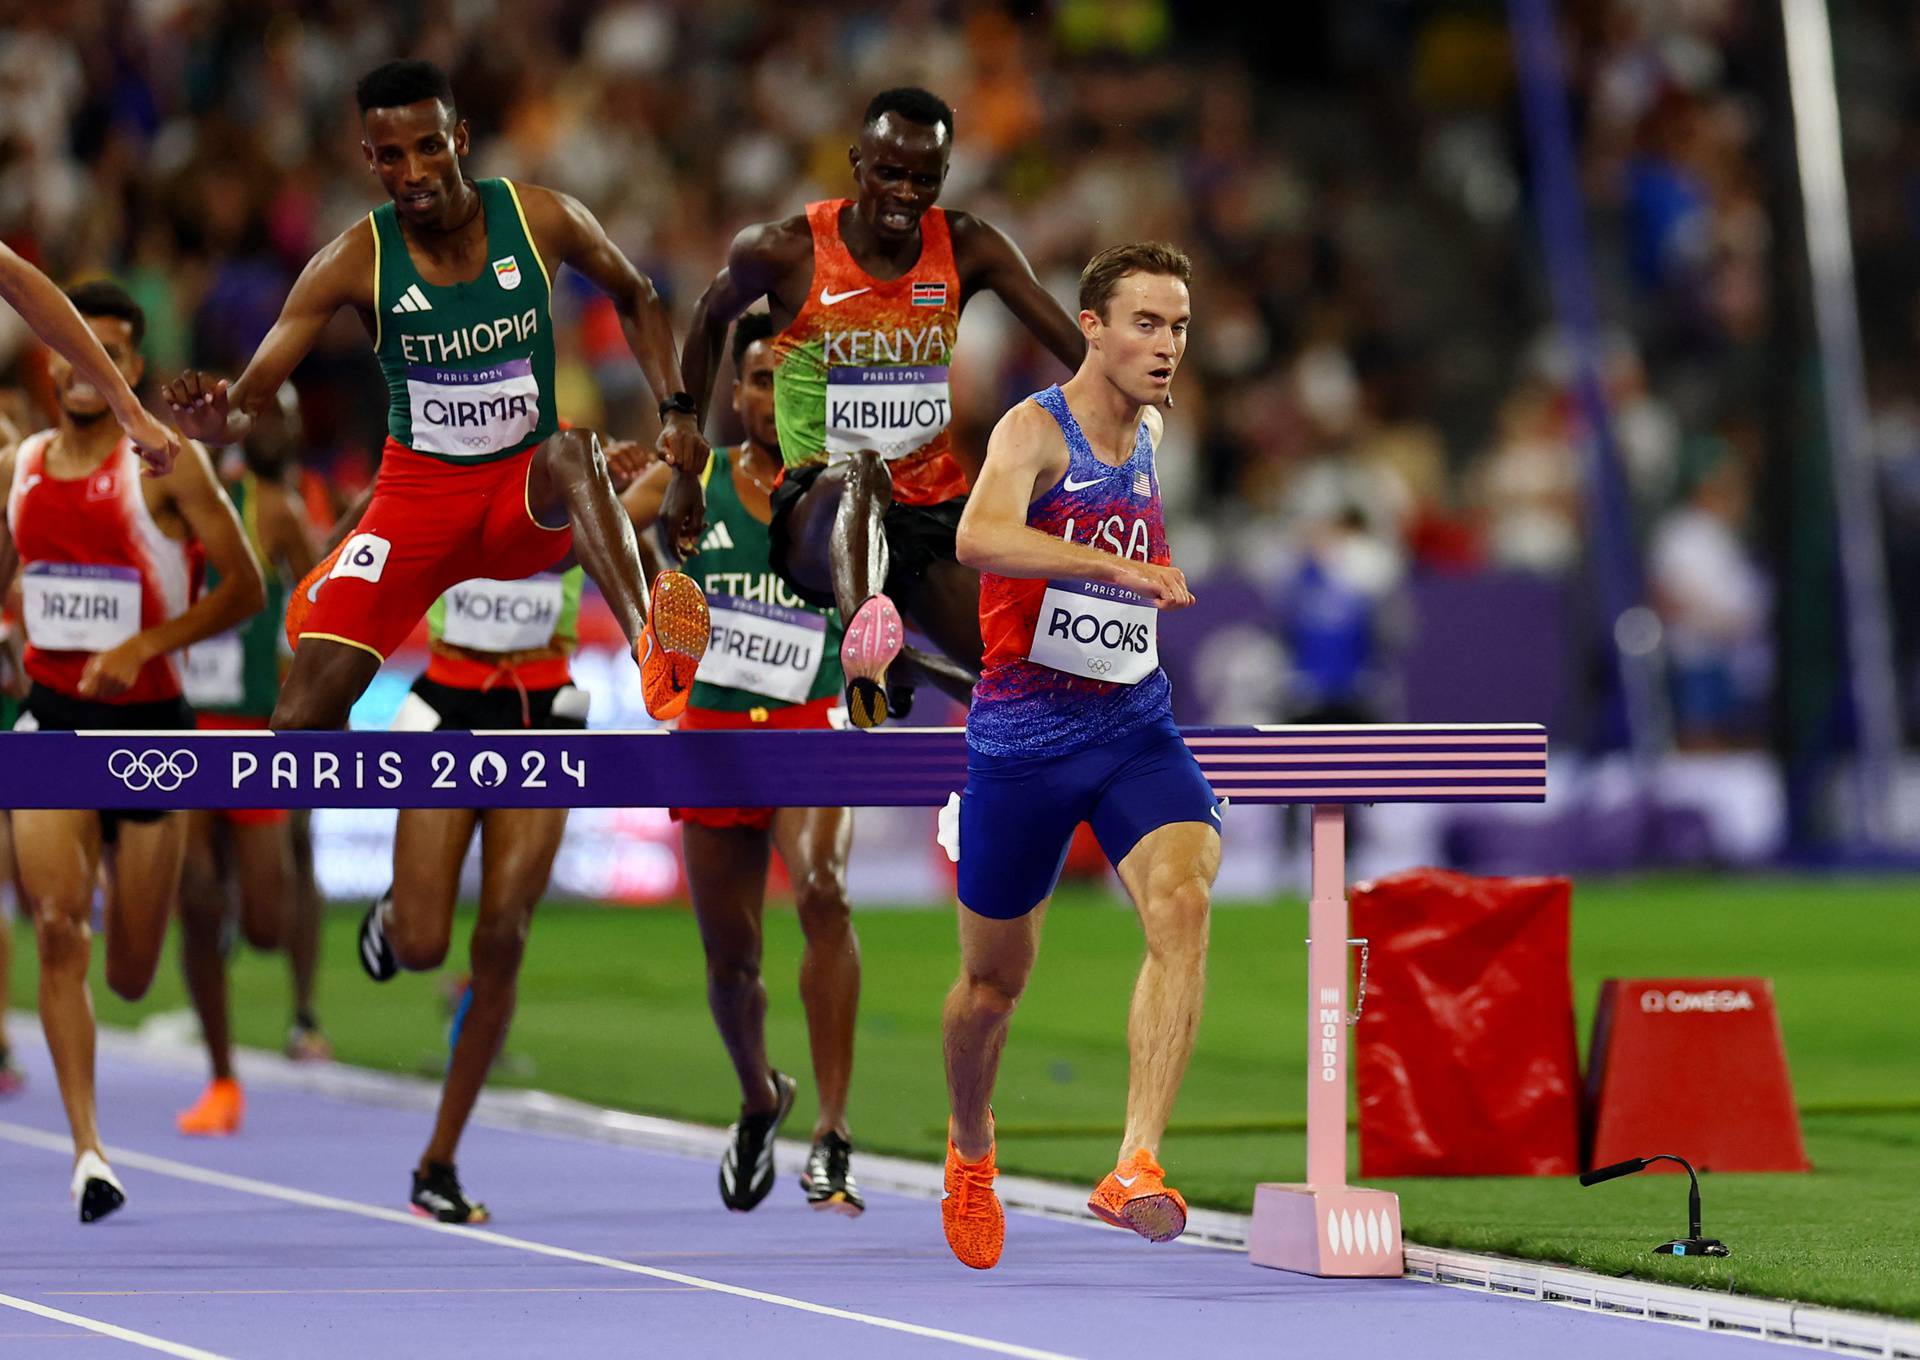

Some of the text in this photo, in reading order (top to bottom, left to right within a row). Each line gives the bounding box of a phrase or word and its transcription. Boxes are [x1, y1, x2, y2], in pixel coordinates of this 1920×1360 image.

[401, 307, 538, 363] ETHIOPIA
[824, 324, 947, 364] KENYA
[436, 369, 503, 382] PARIS 2024
[862, 371, 895, 381] PARIS
[423, 395, 528, 427] GIRMA
[832, 399, 946, 429] KIBIWOT
[343, 544, 375, 567] 16
[1084, 582, 1116, 597] PARIS
[41, 591, 120, 622] JAZIRI
[453, 589, 554, 625] KOECH
[1047, 607, 1149, 655] ROOKS
[709, 625, 811, 672] FIREWU
[430, 750, 586, 789] 2024
[1665, 989, 1756, 1014] OMEGA
[1319, 1008, 1340, 1083] MONDO
